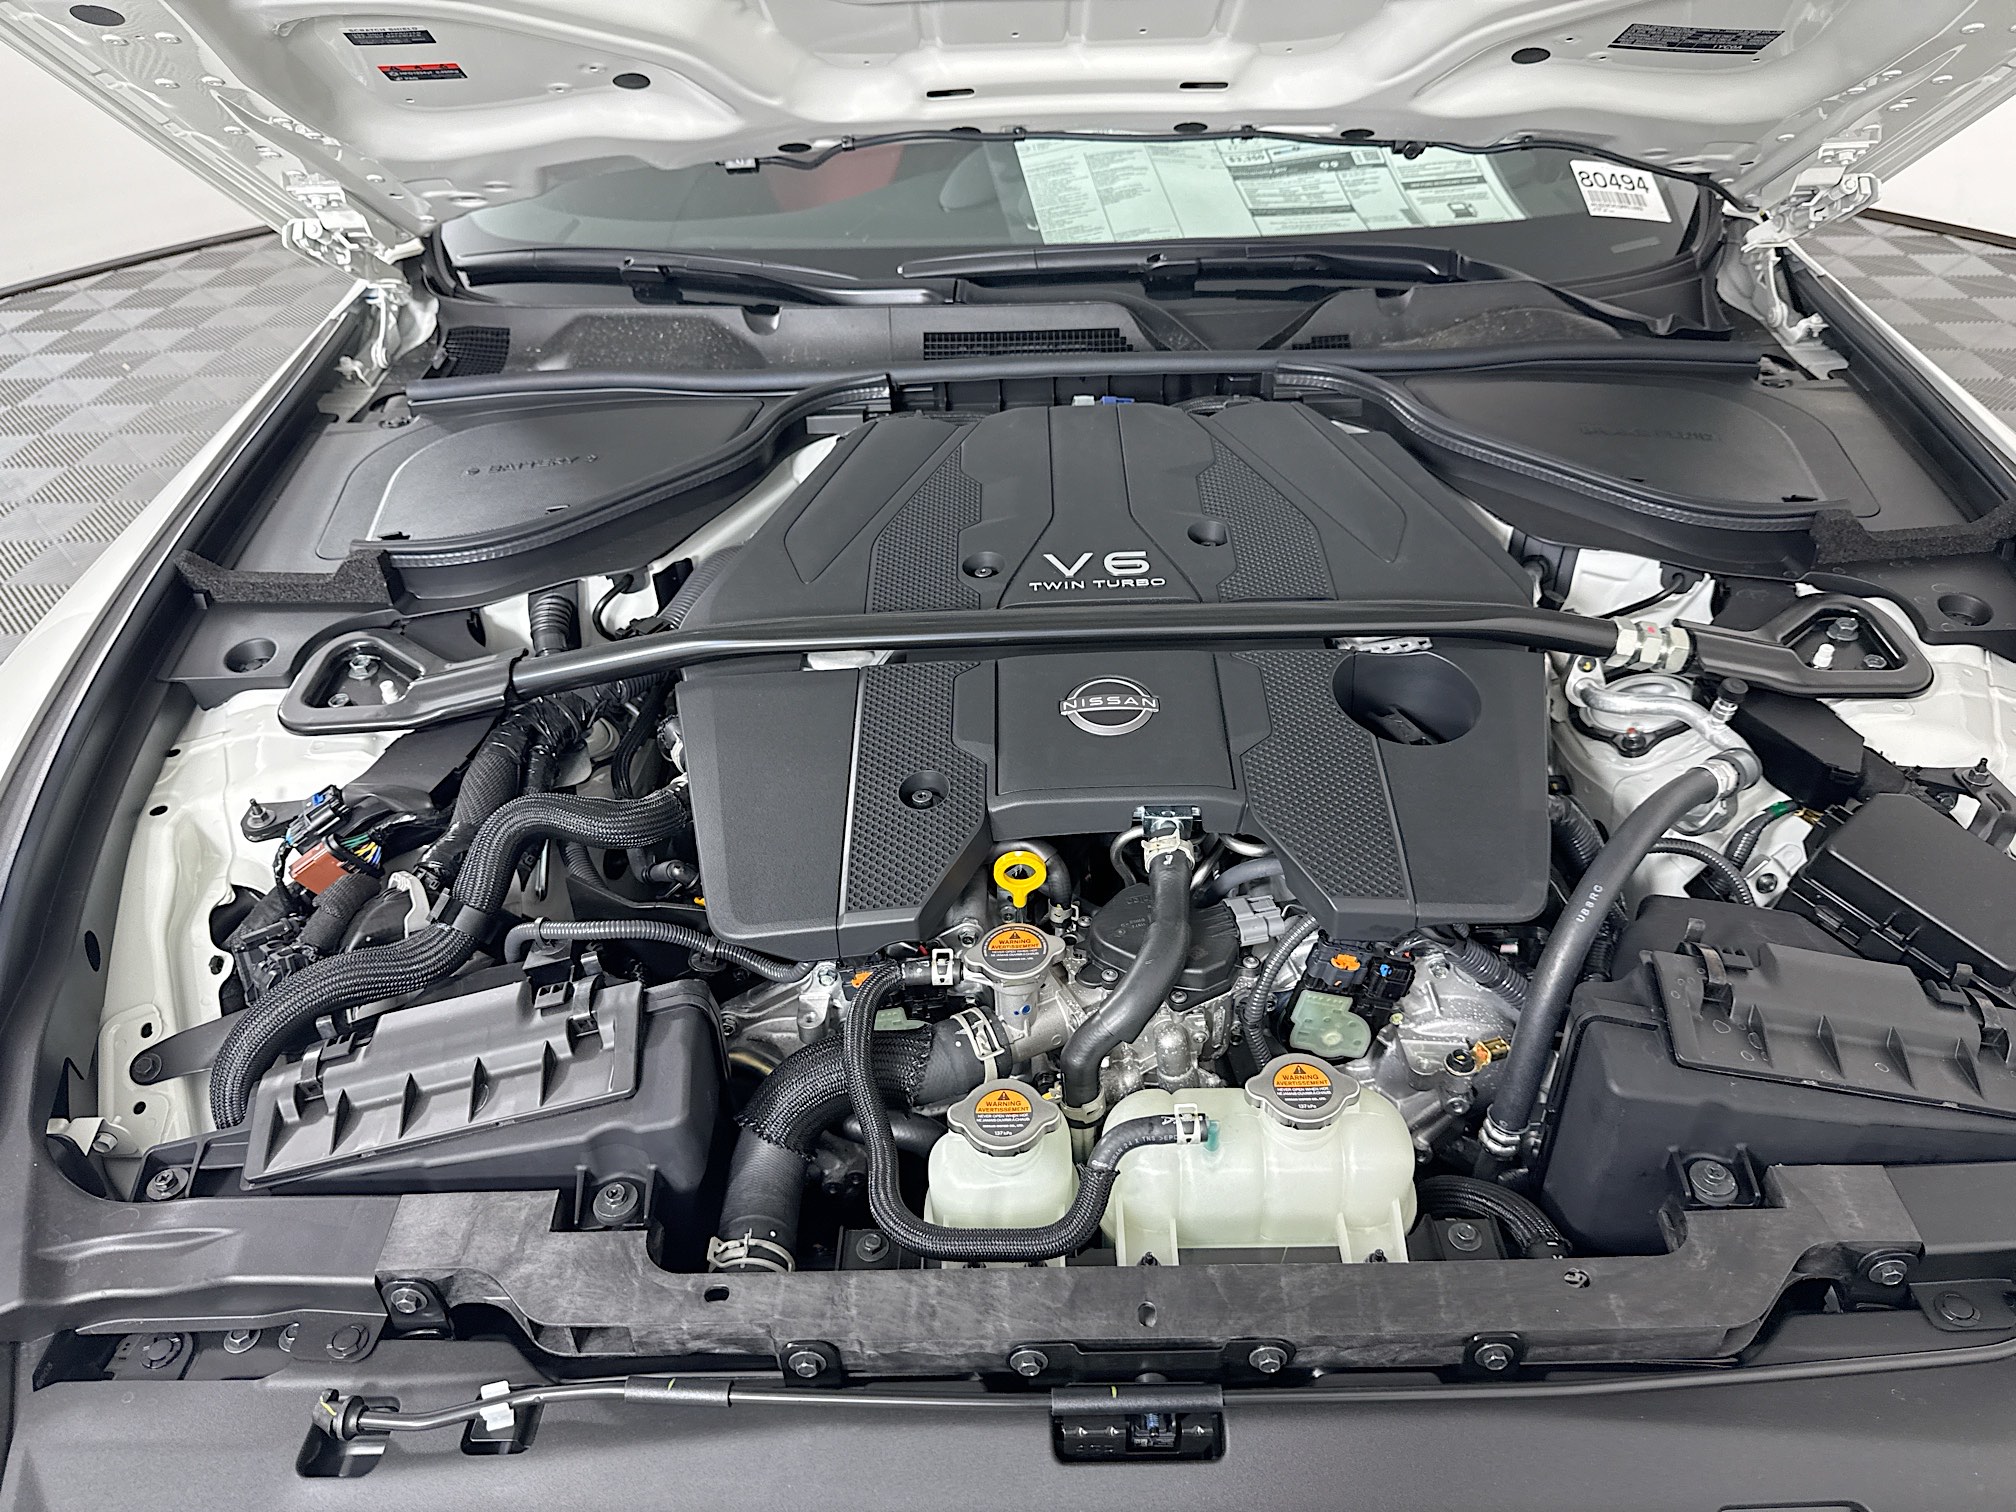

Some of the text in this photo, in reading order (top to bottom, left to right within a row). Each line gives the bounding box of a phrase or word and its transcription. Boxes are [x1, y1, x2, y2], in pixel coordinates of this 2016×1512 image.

[1578, 171, 1649, 194] 80494
[1042, 550, 1150, 579] V6
[1028, 577, 1166, 592] TWIN TURBO
[1062, 695, 1157, 711] NISSAN
[1123, 1140, 1133, 1148] 24
